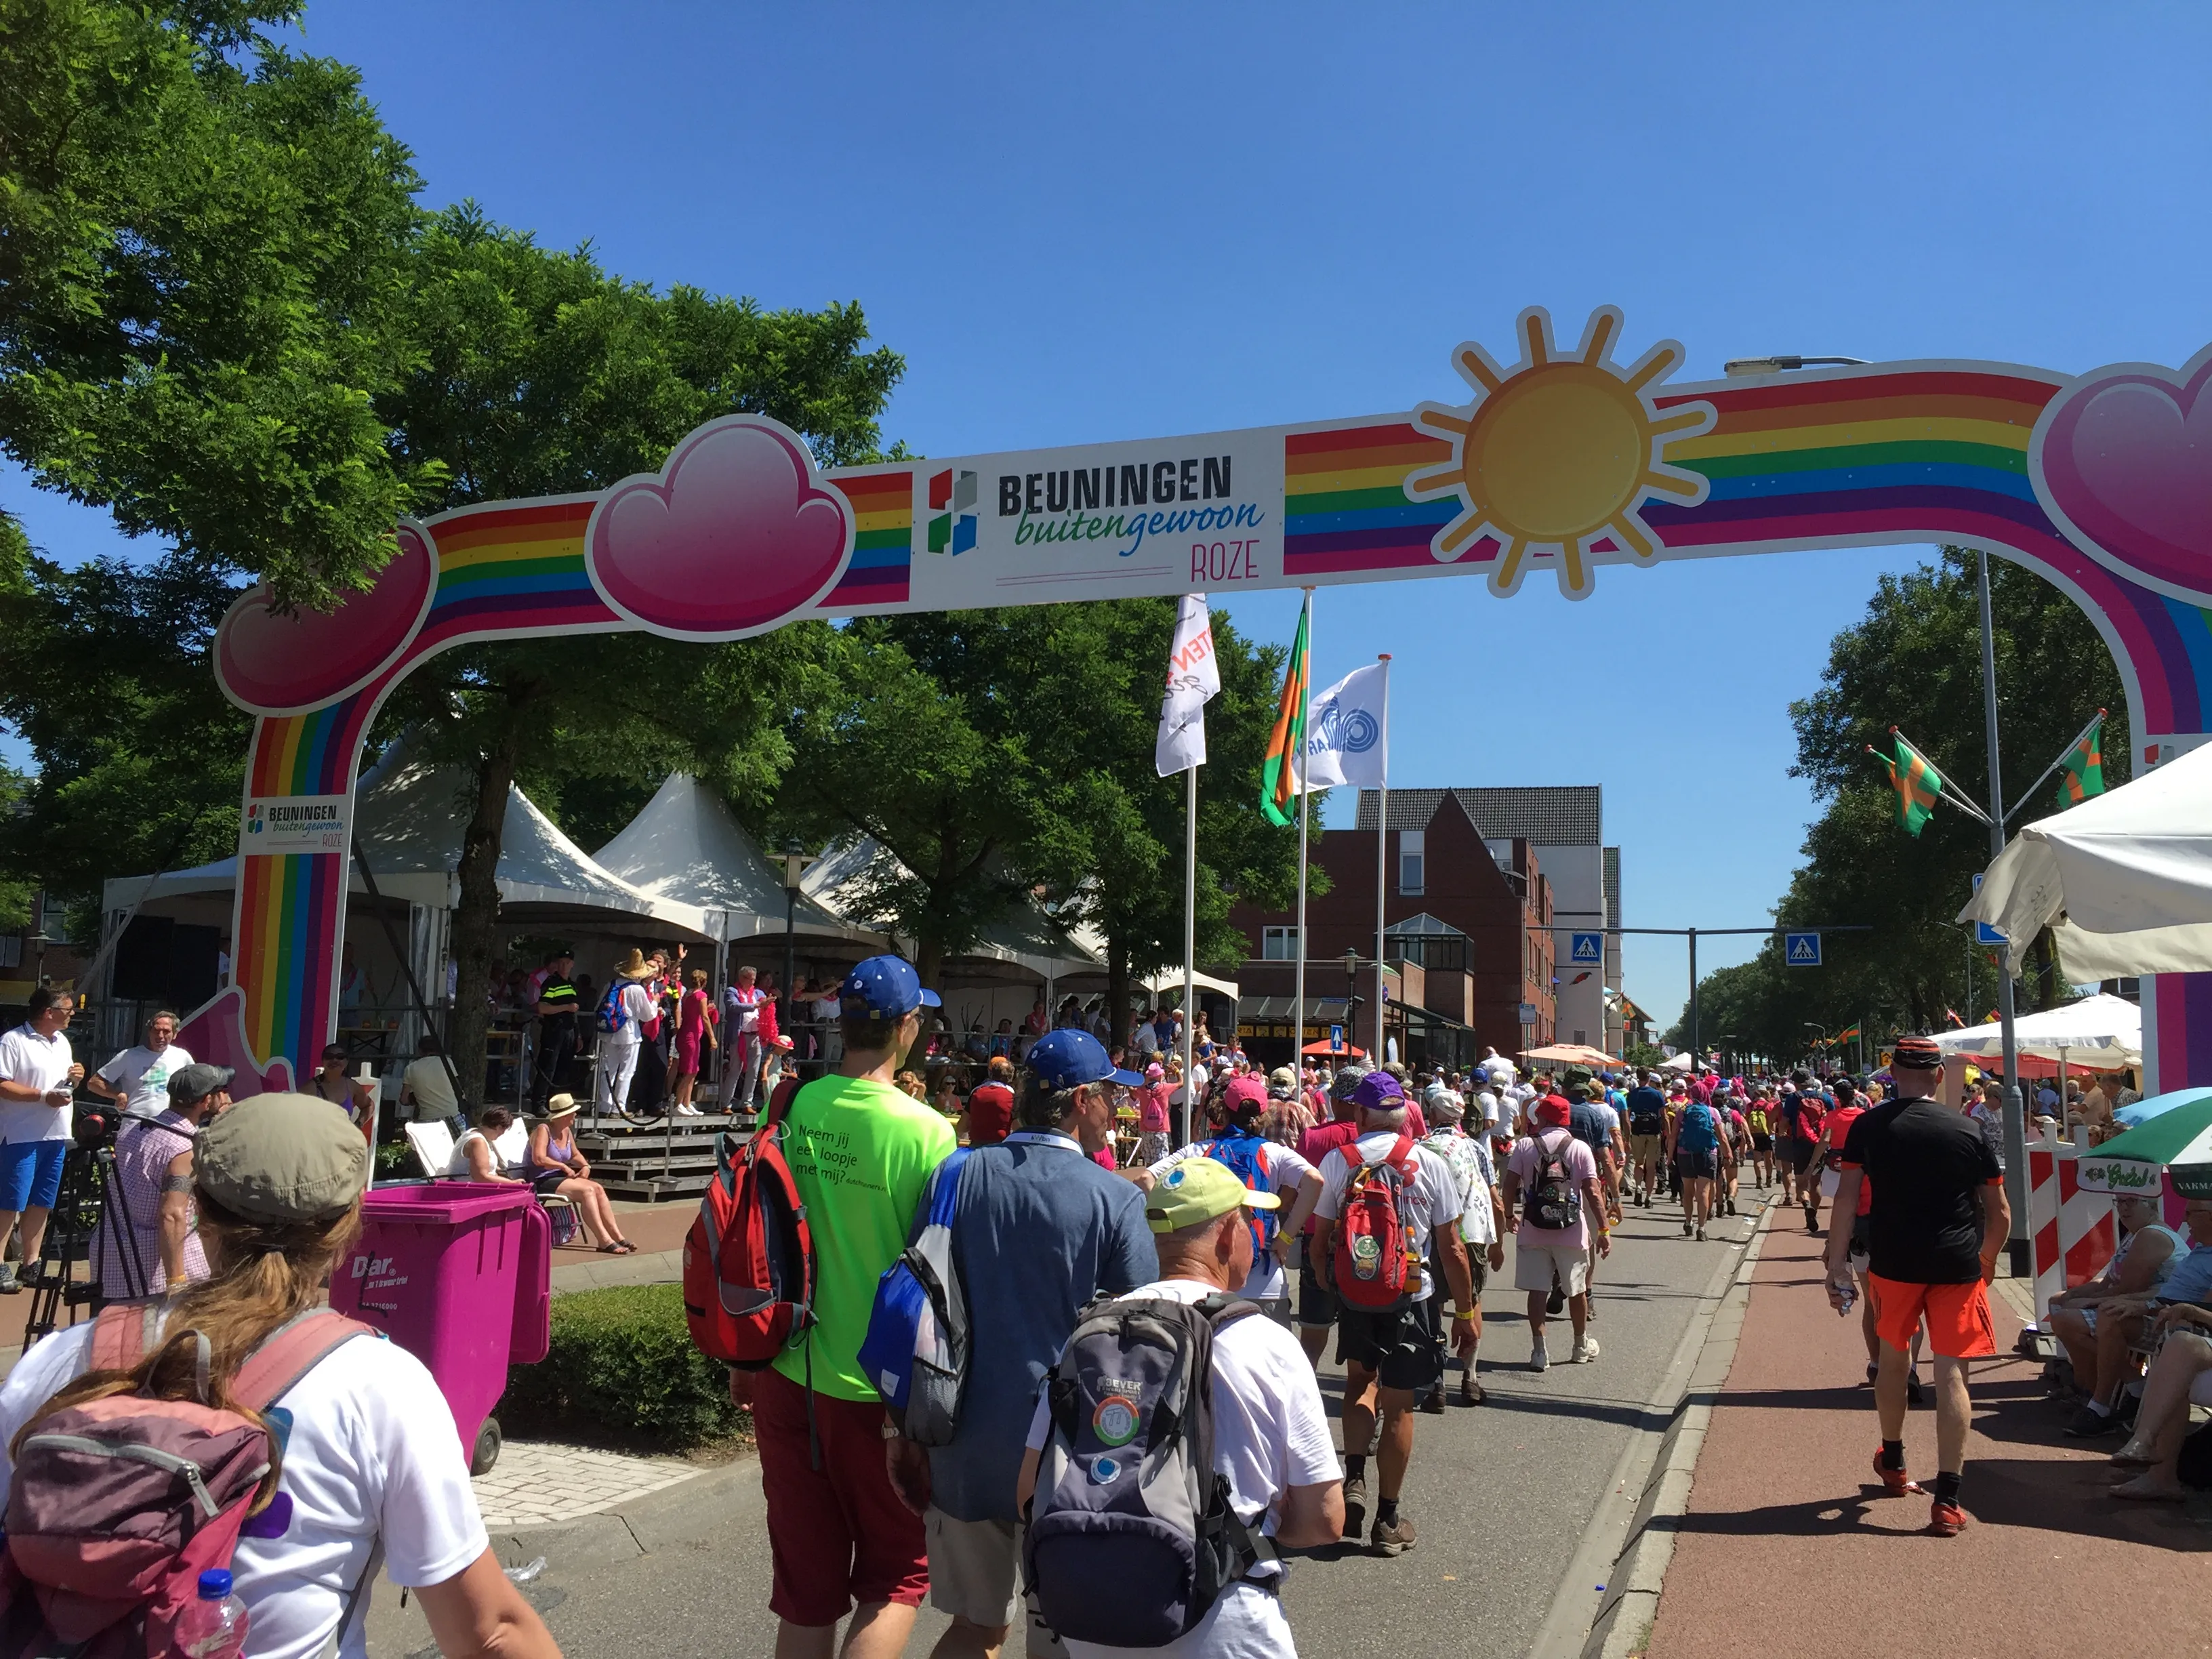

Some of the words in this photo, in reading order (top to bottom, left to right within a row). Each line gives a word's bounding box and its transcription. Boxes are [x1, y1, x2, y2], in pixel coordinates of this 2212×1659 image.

[998, 455, 1231, 517] BEUNINGEN
[1015, 503, 1266, 557] buitengewoon
[1191, 539, 1261, 583] ROZE
[269, 805, 337, 822] BEUNINGEN
[272, 819, 344, 838] buitengewoon
[322, 834, 343, 848] ROZE
[798, 1124, 834, 1143] Neem
[836, 1132, 850, 1149] jij
[796, 1145, 816, 1158] een
[820, 1147, 857, 1168] loopje
[796, 1163, 818, 1176] met
[821, 1169, 846, 1186] mij?
